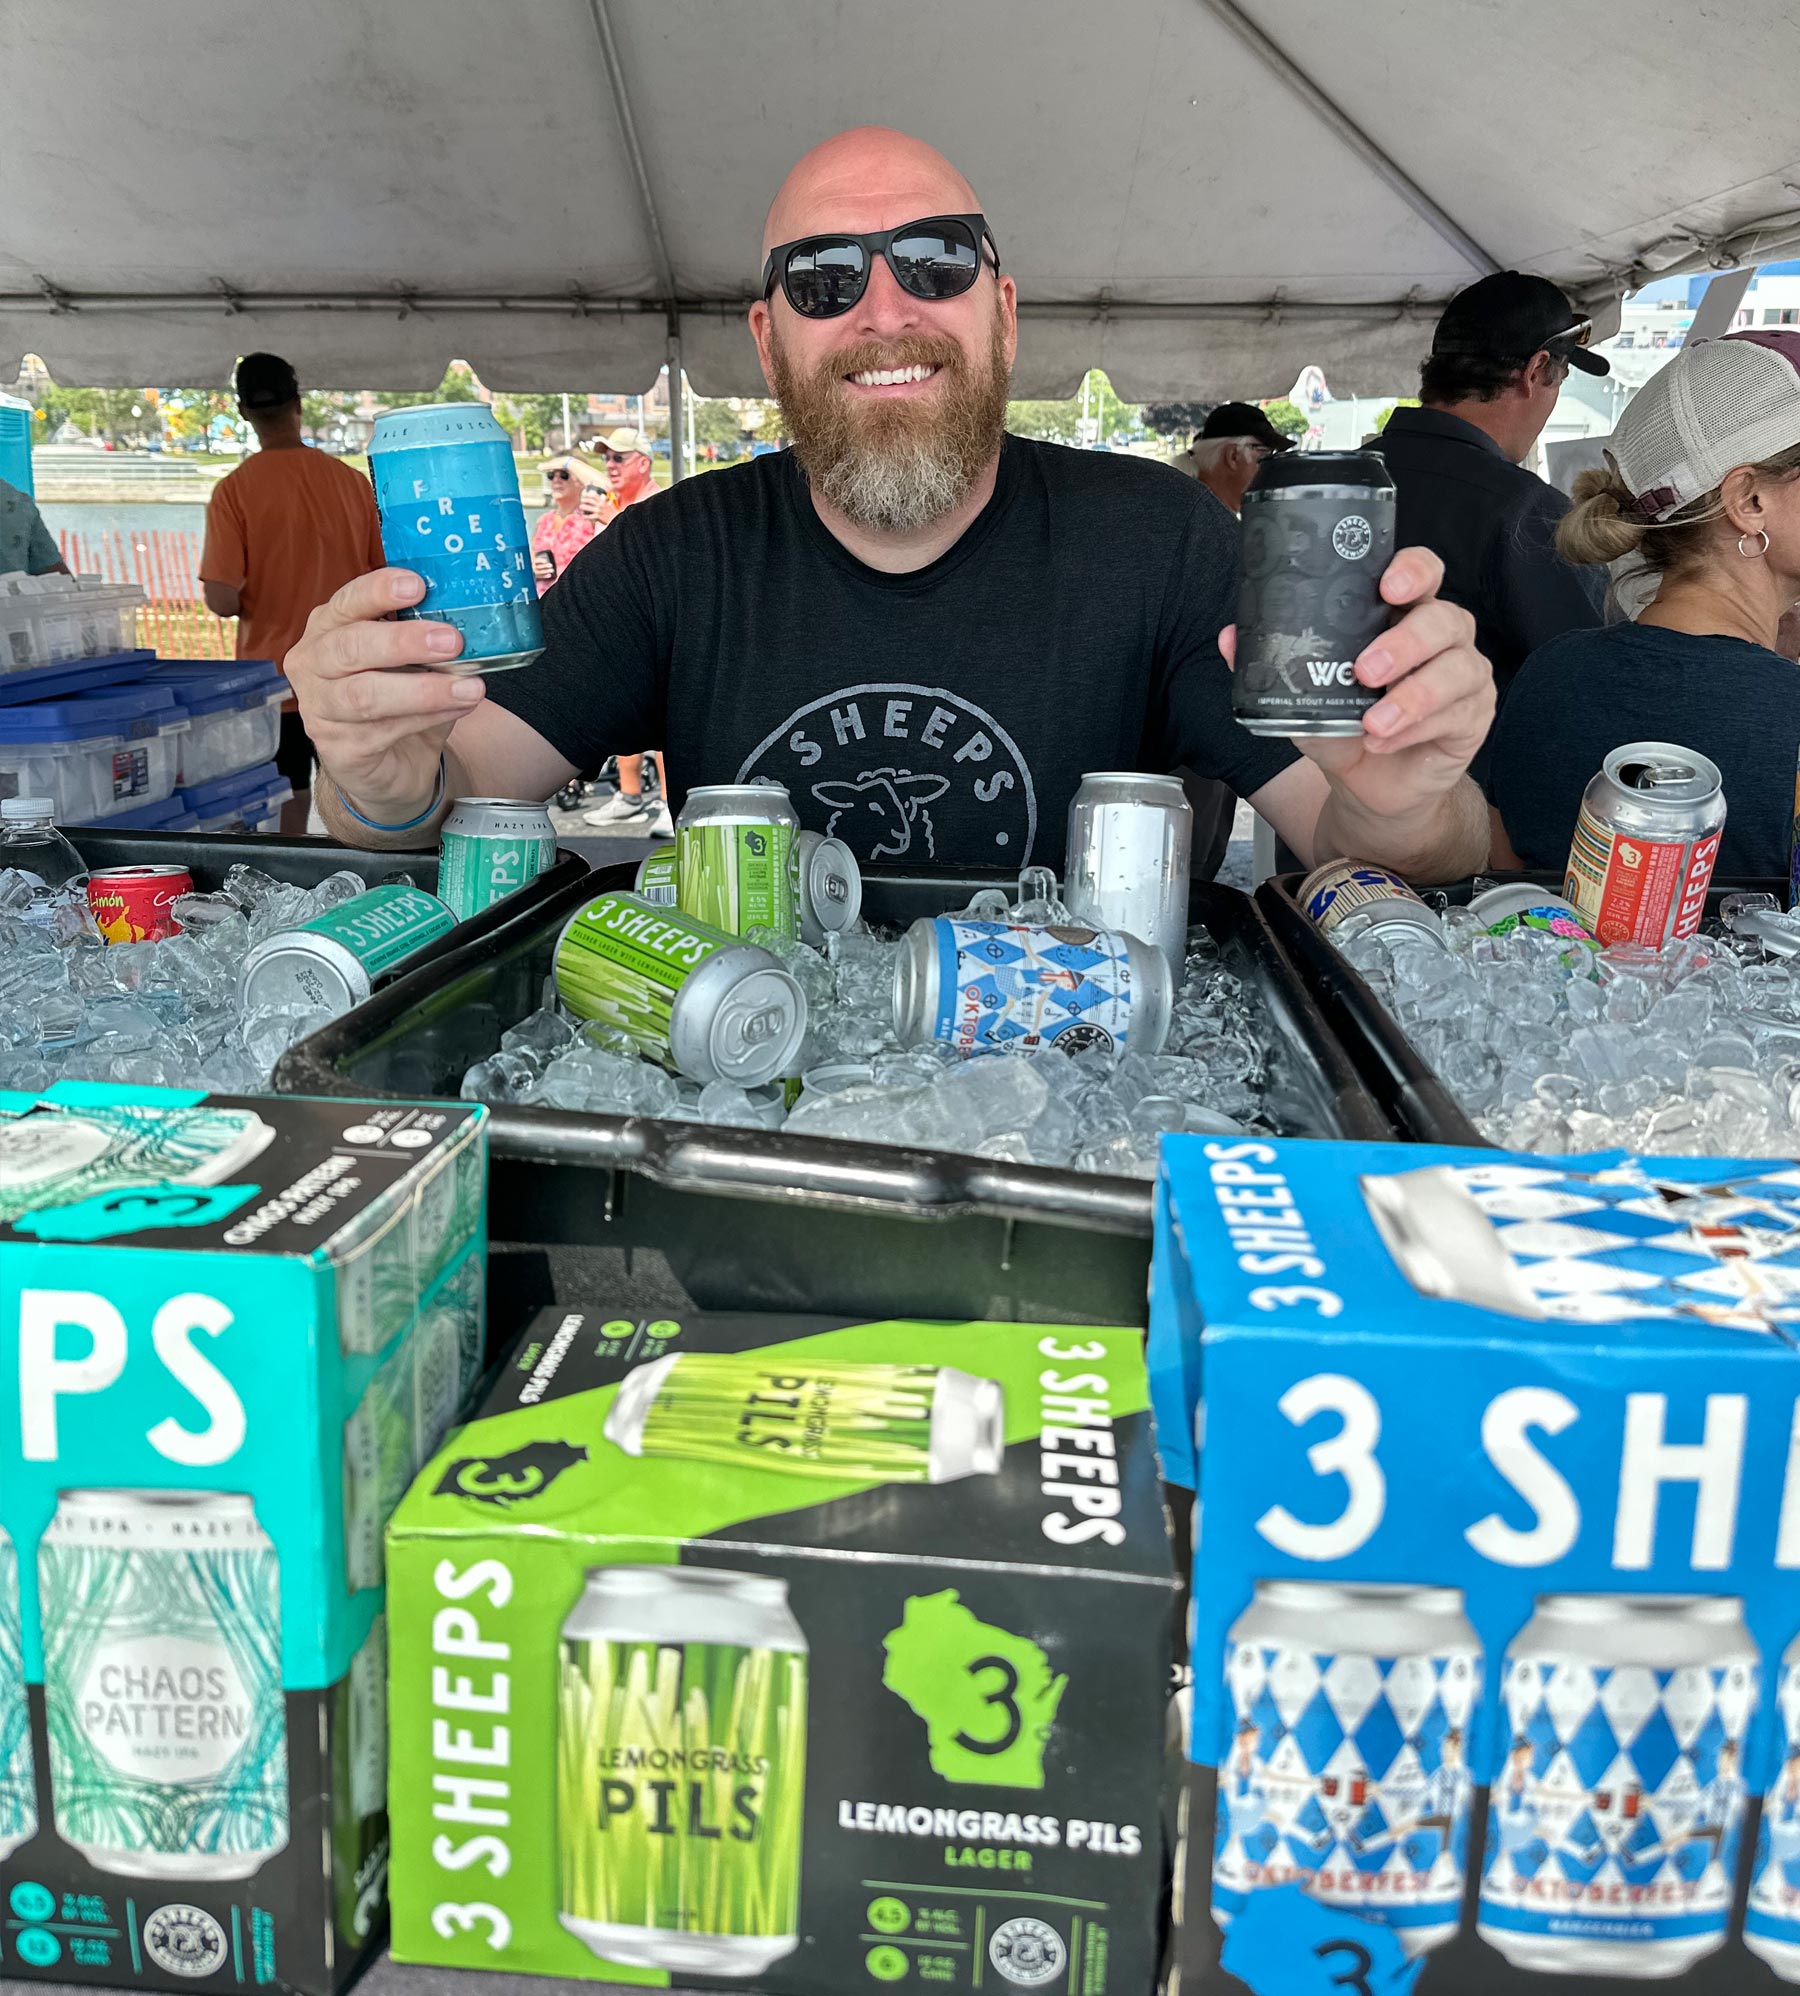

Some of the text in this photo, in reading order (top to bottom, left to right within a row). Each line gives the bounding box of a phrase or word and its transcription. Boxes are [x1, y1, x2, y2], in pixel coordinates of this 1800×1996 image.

[1257, 697, 1293, 706] IMPERIAL
[1295, 697, 1323, 706] STOUT
[1325, 698, 1345, 706] AGED
[788, 699, 1015, 803] SHEEPS
[494, 822, 525, 830] HAZY
[753, 837, 764, 854] 3
[1625, 850, 1638, 865] 3
[89, 888, 125, 909] Limón
[1676, 837, 1718, 938] HEEPS
[335, 891, 436, 948] 3 SHEEPS
[572, 928, 598, 947] PILSNER
[586, 899, 713, 964] 3 SHEEPS
[1203, 1141, 1344, 1319] 3 SHEEPS
[533, 1314, 585, 1379] LEMONGRASS
[736, 1371, 808, 1450] PILS
[1038, 1335, 1128, 1547] 3 SHEEPS
[1254, 1372, 1388, 1562] 3
[455, 1458, 545, 1499] 3
[99, 1662, 228, 1703] CHAOS
[952, 1655, 1023, 1756] 3
[83, 1702, 247, 1741] PATTERN
[430, 1558, 514, 1952] 3 SHEEPS
[597, 1746, 770, 1776] LEMONGRASS
[598, 1778, 763, 1843] PILS
[837, 1797, 1143, 1856] LEMONGRASS PILS
[943, 1844, 1034, 1872] LAGER
[1509, 1875, 1701, 1905] OKTOBERFEST
